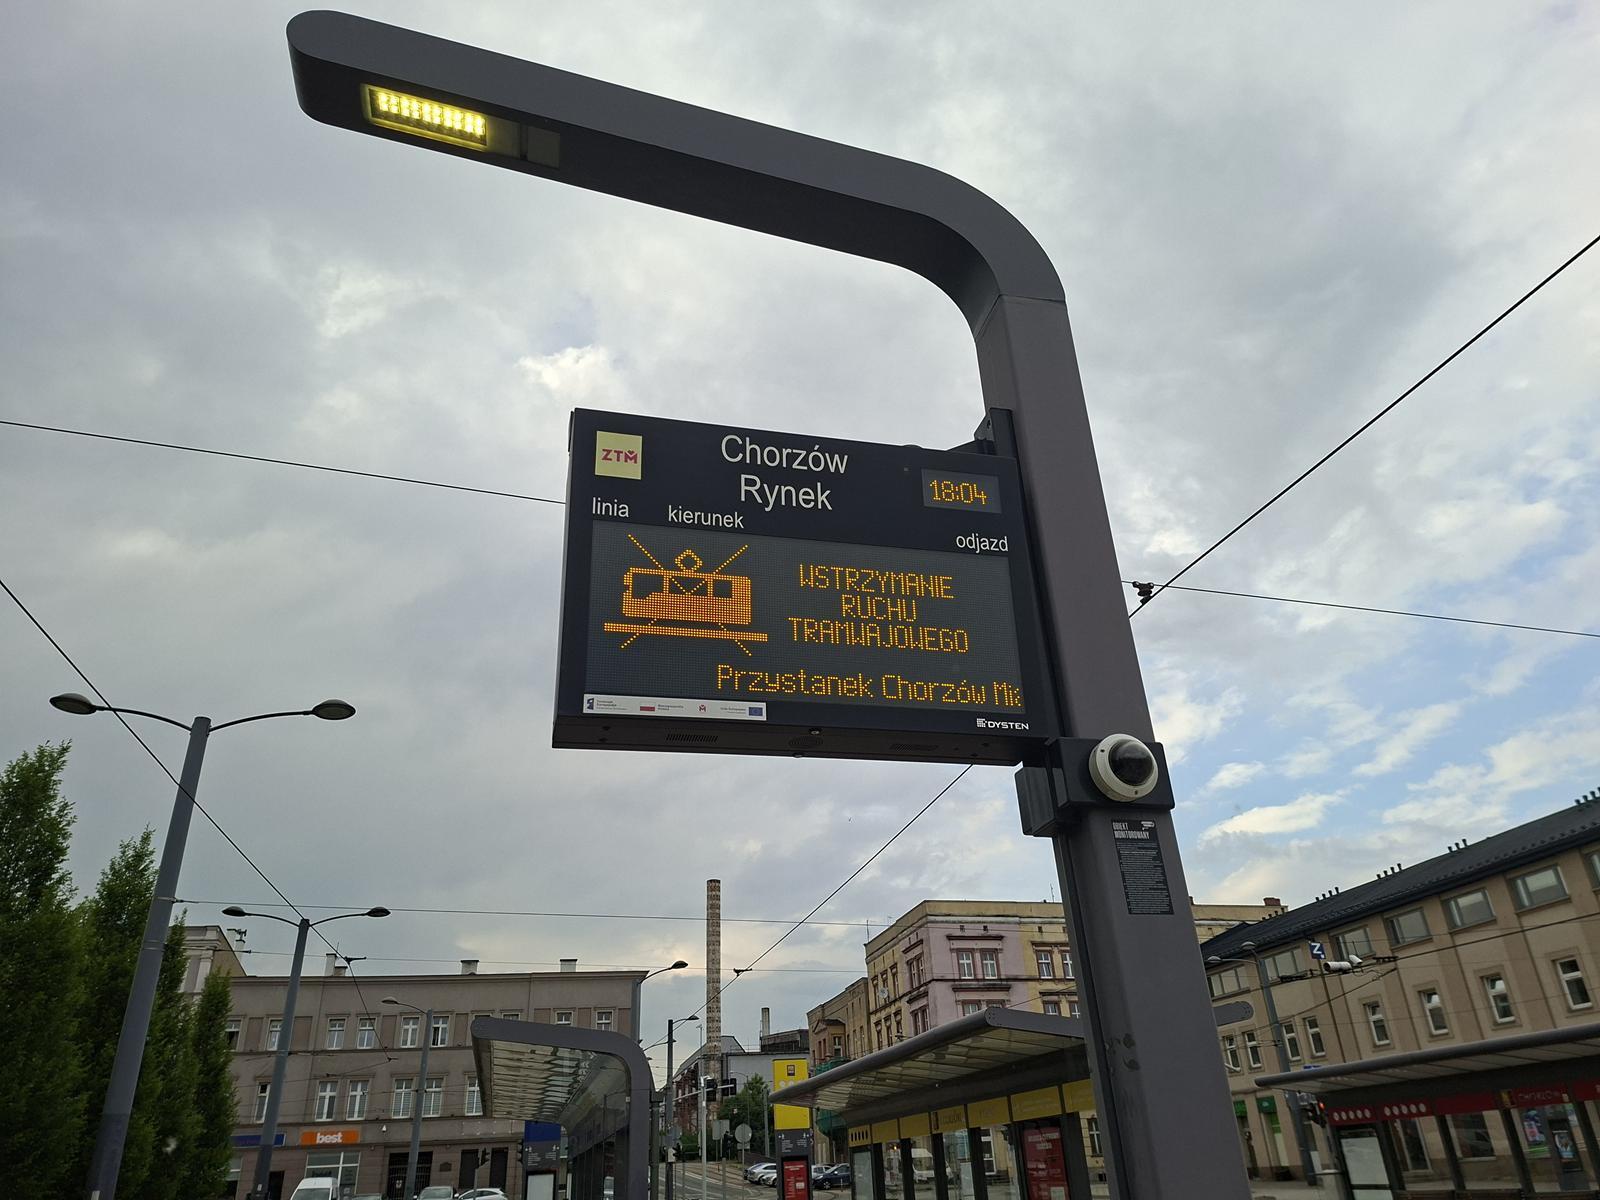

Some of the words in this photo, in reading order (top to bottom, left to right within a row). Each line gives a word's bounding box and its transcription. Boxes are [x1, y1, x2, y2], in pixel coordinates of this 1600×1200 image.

[601, 448, 638, 464] ZTM
[721, 434, 848, 474] Chorzów
[740, 473, 833, 512] Rynek
[929, 479, 987, 505] 18:04
[592, 496, 630, 518] linia
[667, 504, 744, 529] kierunek
[956, 532, 1009, 554] odjazd
[799, 564, 954, 599] WSTRZYMANIE
[841, 594, 917, 622] RUCHU
[788, 617, 969, 653] TRAMWAJOWEGO
[717, 664, 874, 698] Przystanek
[882, 673, 986, 704] Chorzów
[987, 720, 1029, 730] DYSTEN
[315, 1131, 343, 1144] best
